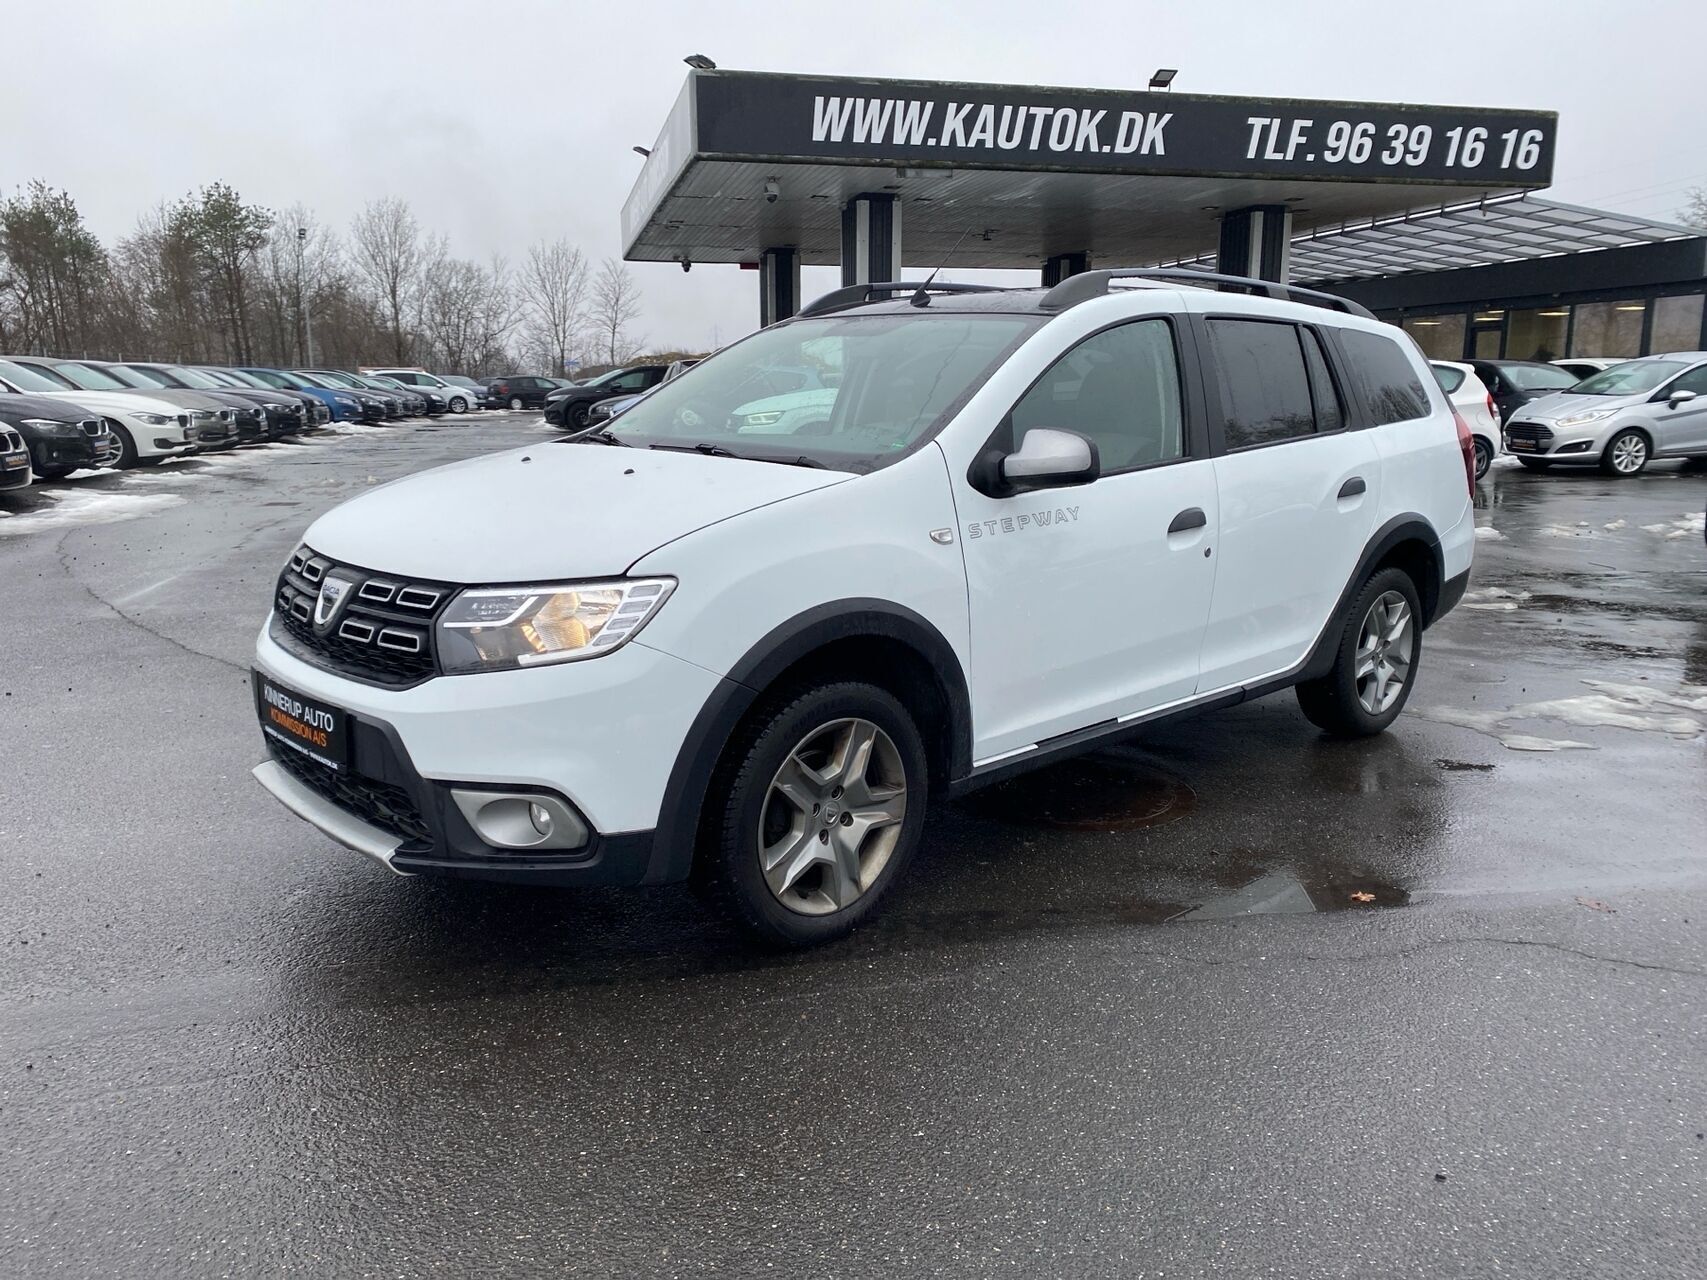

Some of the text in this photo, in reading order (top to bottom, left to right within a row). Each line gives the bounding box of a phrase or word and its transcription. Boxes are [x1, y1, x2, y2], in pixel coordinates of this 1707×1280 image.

[812, 96, 1173, 155] WWW.KAUTOK.DK
[1246, 117, 1544, 170] TLF. 96 39 16 16
[968, 506, 1080, 540] STEPWAY
[304, 706, 334, 732] AUTO
